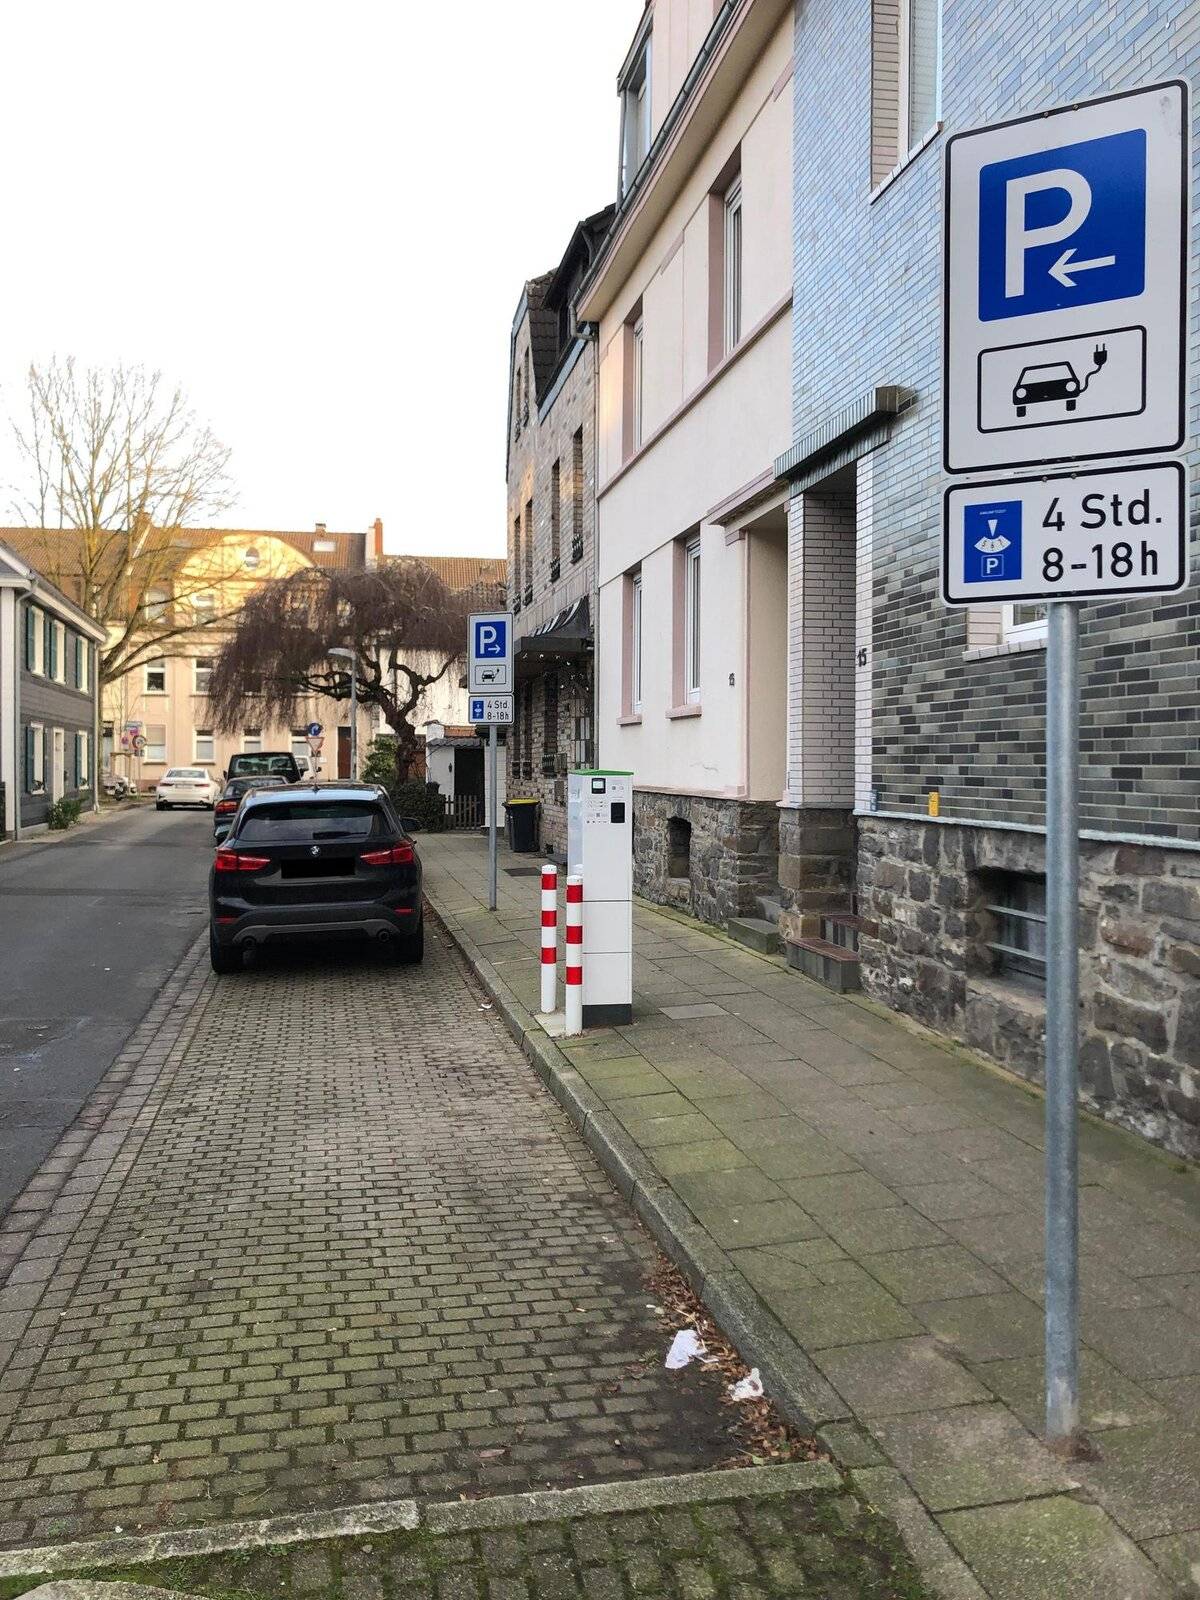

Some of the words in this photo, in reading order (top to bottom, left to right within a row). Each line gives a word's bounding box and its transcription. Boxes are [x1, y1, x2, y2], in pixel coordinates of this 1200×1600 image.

[1004, 168, 1093, 299] P
[1042, 497, 1066, 532] 4
[1079, 488, 1162, 529] Std.
[986, 557, 999, 574] P
[1042, 540, 1158, 583] 8-18h
[480, 625, 497, 655] P
[857, 647, 867, 668] 15
[487, 700, 492, 709] 4
[494, 700, 510, 709] Std.
[487, 711, 510, 720] 8-18h
